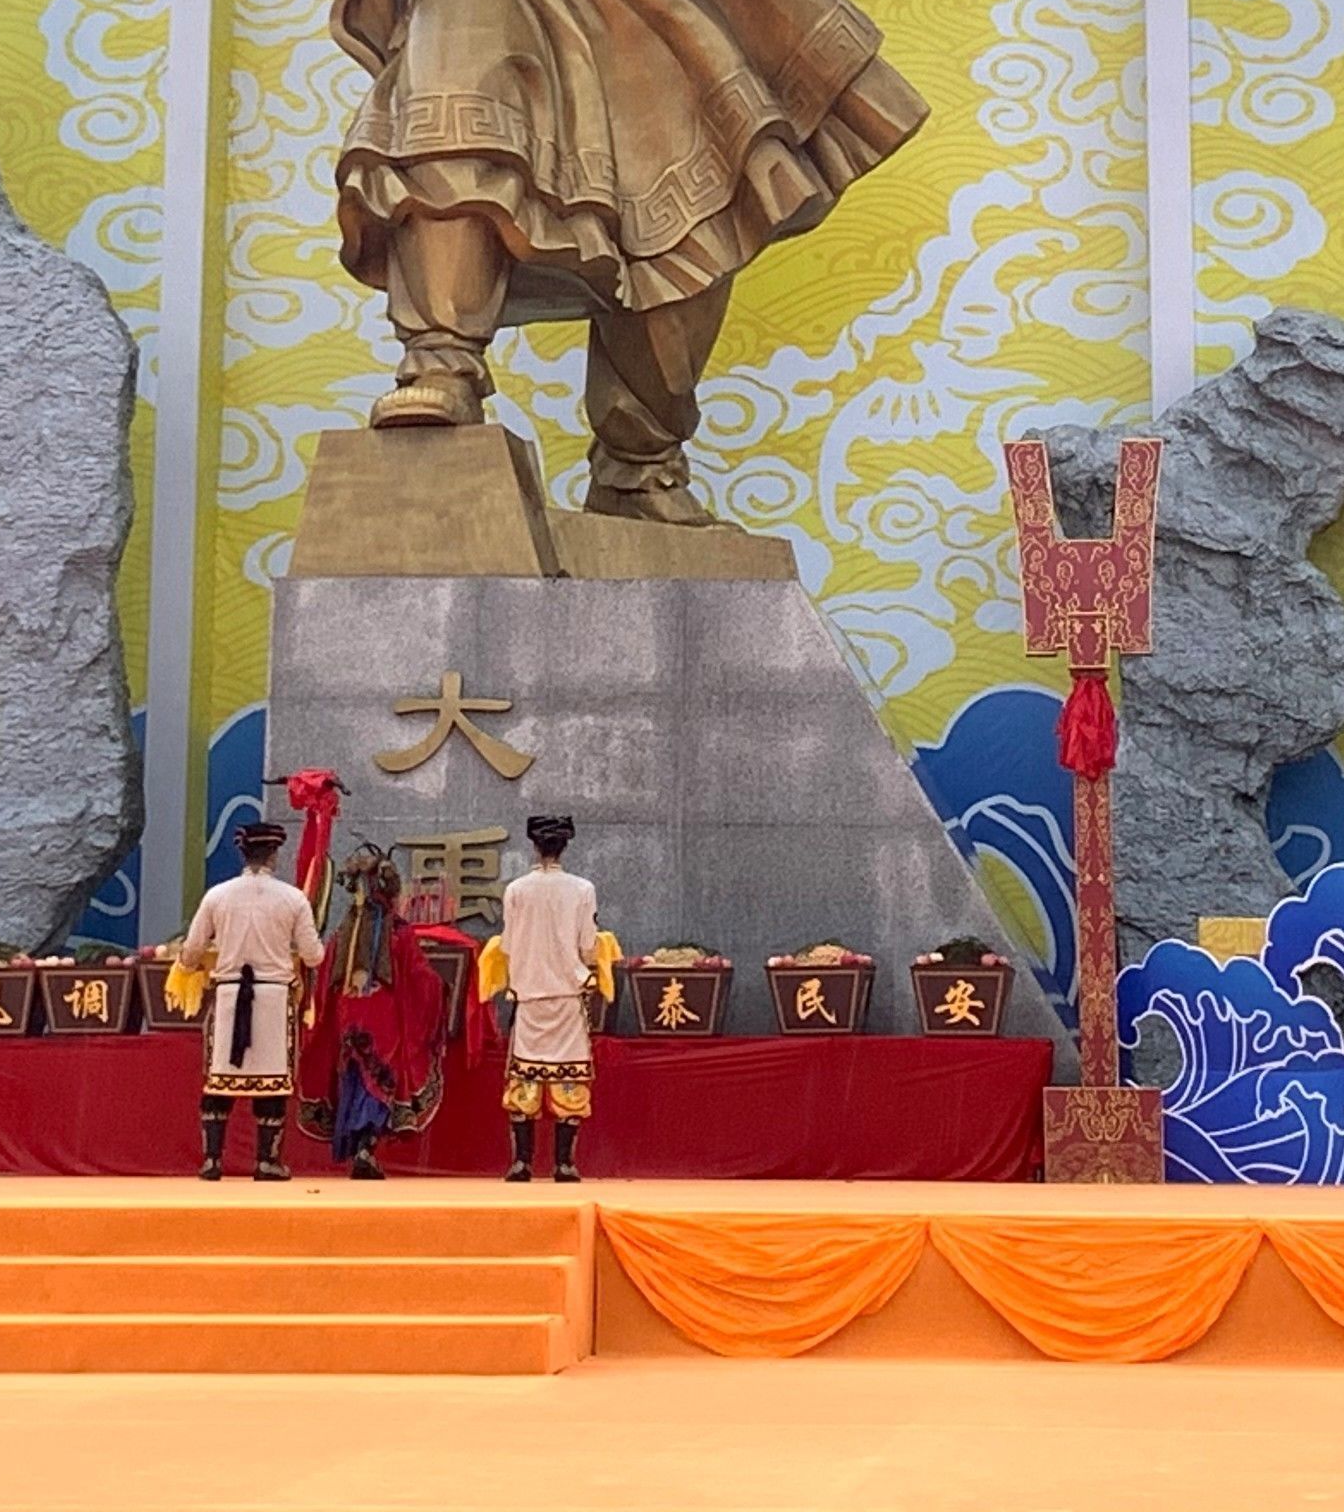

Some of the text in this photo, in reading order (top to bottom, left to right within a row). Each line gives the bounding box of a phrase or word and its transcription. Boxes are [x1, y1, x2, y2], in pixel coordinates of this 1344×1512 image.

[63, 979, 109, 1023] 调
[654, 977, 701, 1030] 泰
[796, 978, 836, 1025] 民
[934, 979, 985, 1026] 安
